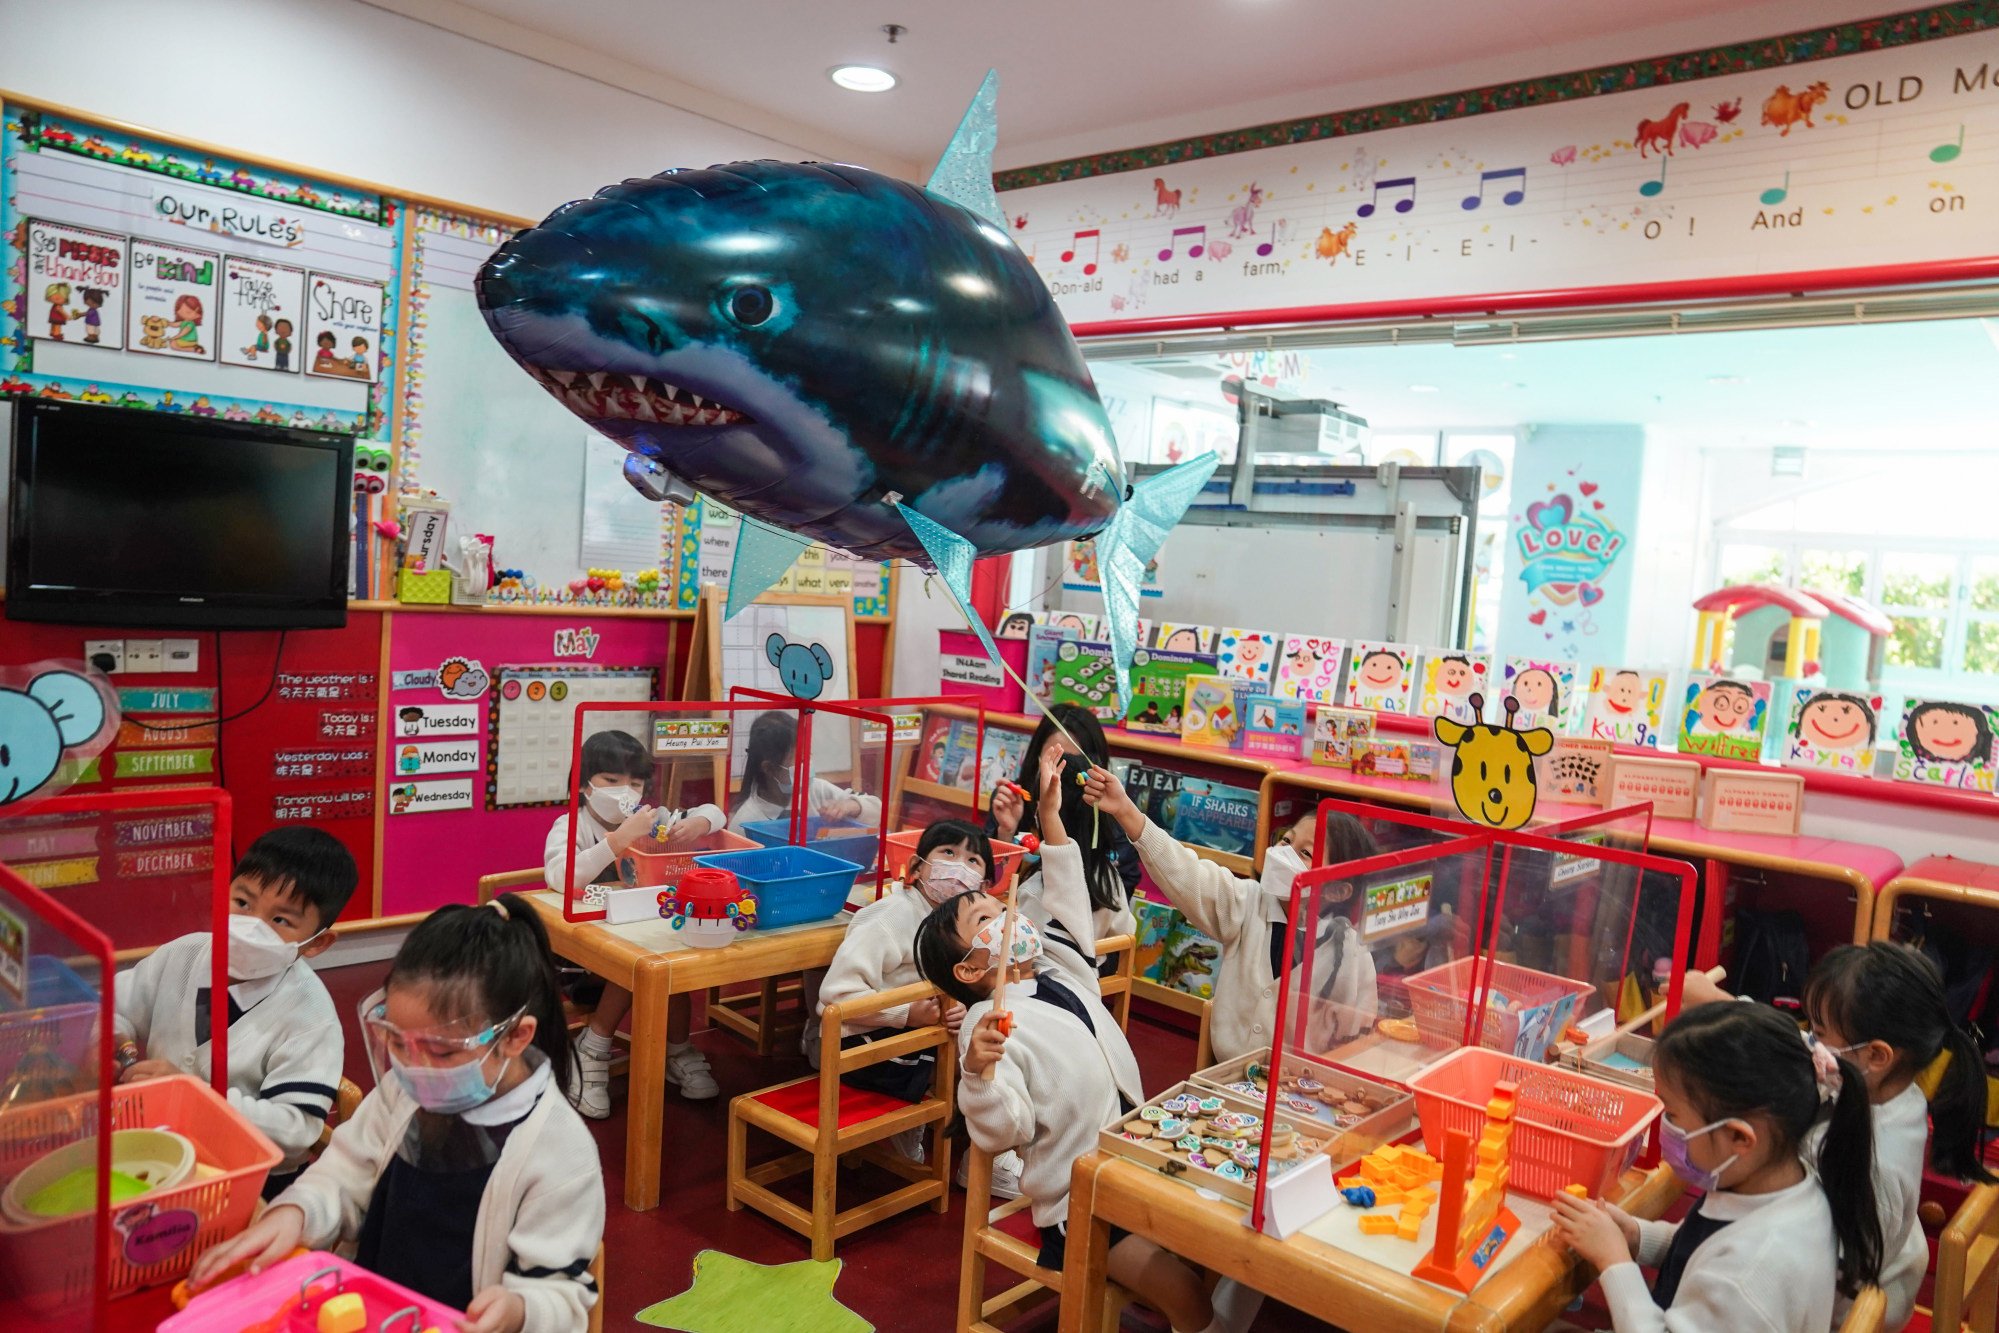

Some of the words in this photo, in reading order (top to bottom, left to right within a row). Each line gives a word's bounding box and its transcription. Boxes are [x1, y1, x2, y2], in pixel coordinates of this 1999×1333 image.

[1845, 76, 1923, 110] OLD
[160, 195, 209, 222] Our
[222, 207, 297, 242] Rules
[1153, 269, 1179, 285] had
[1195, 270, 1203, 281] a
[1243, 262, 1286, 276] farm,
[1751, 207, 1803, 229] And
[1929, 195, 1965, 213] on
[157, 256, 213, 285] kind
[313, 282, 373, 324] Share
[421, 516, 440, 558] ursday
[704, 537, 730, 548] where
[804, 550, 819, 560] this
[702, 566, 728, 578] there
[798, 577, 822, 588] what
[556, 632, 599, 657] May
[1152, 653, 1194, 664] Dominoes
[279, 674, 303, 684] The
[305, 674, 355, 685] weather
[969, 672, 1000, 685] Reading
[1284, 681, 1330, 704] Grace
[151, 693, 180, 709] JULY
[323, 713, 358, 724] Today
[423, 716, 476, 728] Tuesday
[132, 754, 195, 772] SEPTEMBER
[275, 752, 339, 762] Yesterday
[423, 750, 476, 763] Monday
[275, 796, 333, 806] Tomorrow
[334, 793, 349, 802] will
[415, 791, 471, 803] Wednesday
[1191, 795, 1202, 807] IF
[1204, 798, 1248, 817] SHARKS
[1180, 806, 1256, 831] DISAPPEARED
[132, 821, 194, 841] NOVEMBER
[137, 854, 194, 872] DECEMBER
